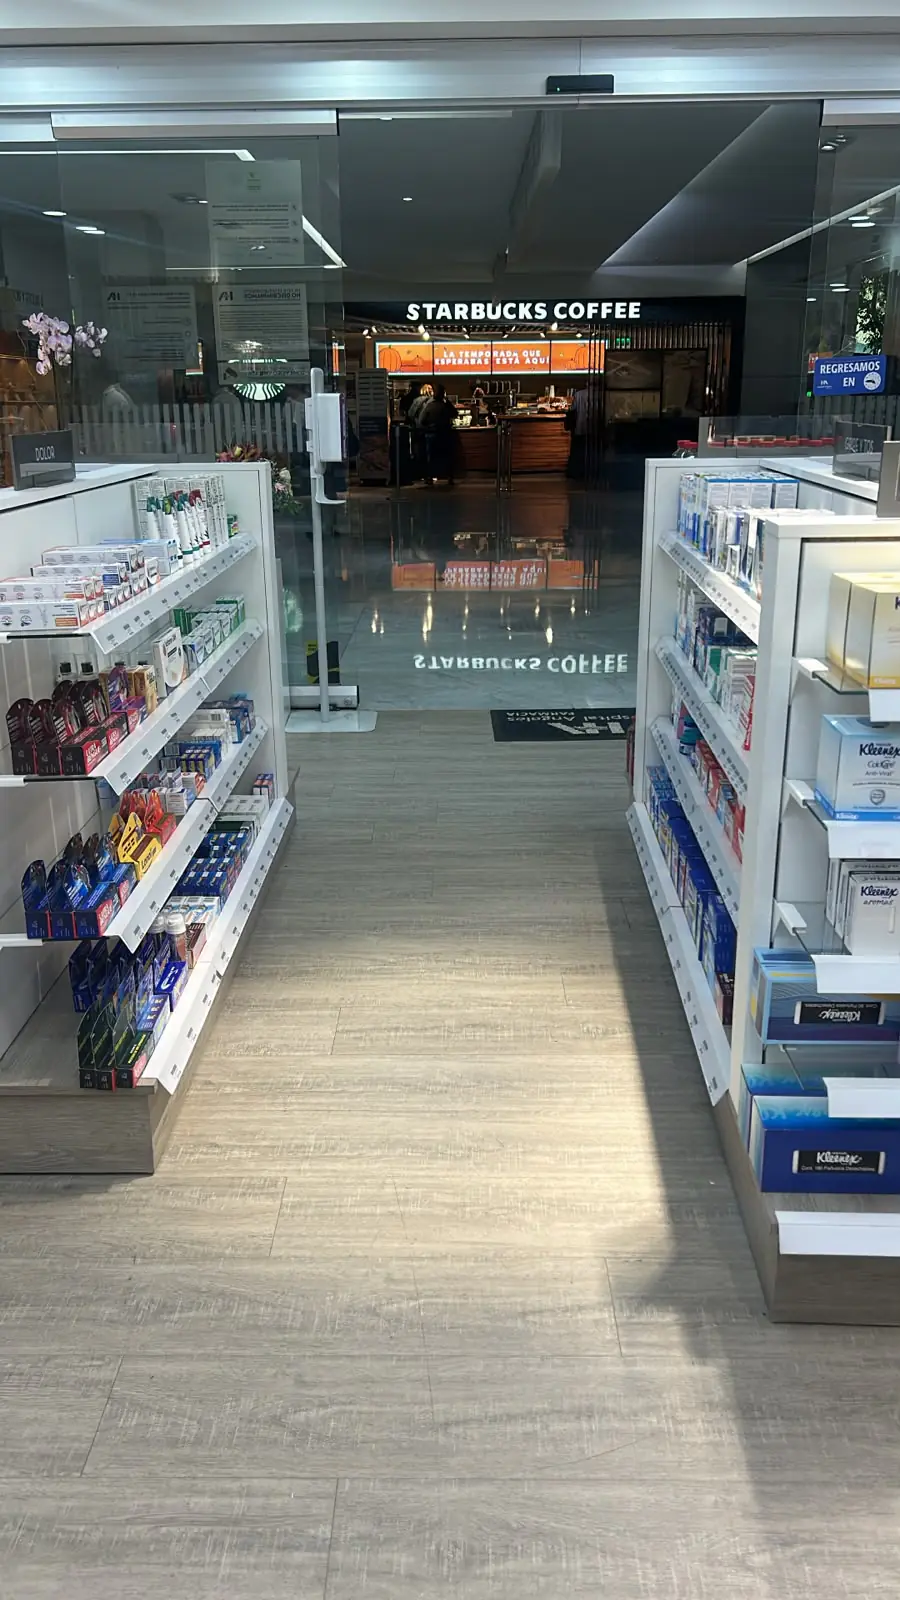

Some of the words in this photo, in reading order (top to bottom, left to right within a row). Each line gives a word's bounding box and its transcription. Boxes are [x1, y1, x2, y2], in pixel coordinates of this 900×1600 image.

[406, 303, 548, 321] STARBUCKS
[554, 302, 641, 319] COFFEE
[443, 350, 455, 358] LA
[459, 350, 519, 358] TEMPORADA
[820, 361, 880, 374] REGRESAMOS
[843, 377, 855, 387] EN
[35, 446, 55, 461] DOLOR
[859, 742, 900, 758] Kleenex
[860, 885, 899, 899] Kleenex
[818, 1009, 861, 1022] Kleenex
[816, 1151, 862, 1166] Kleenex
